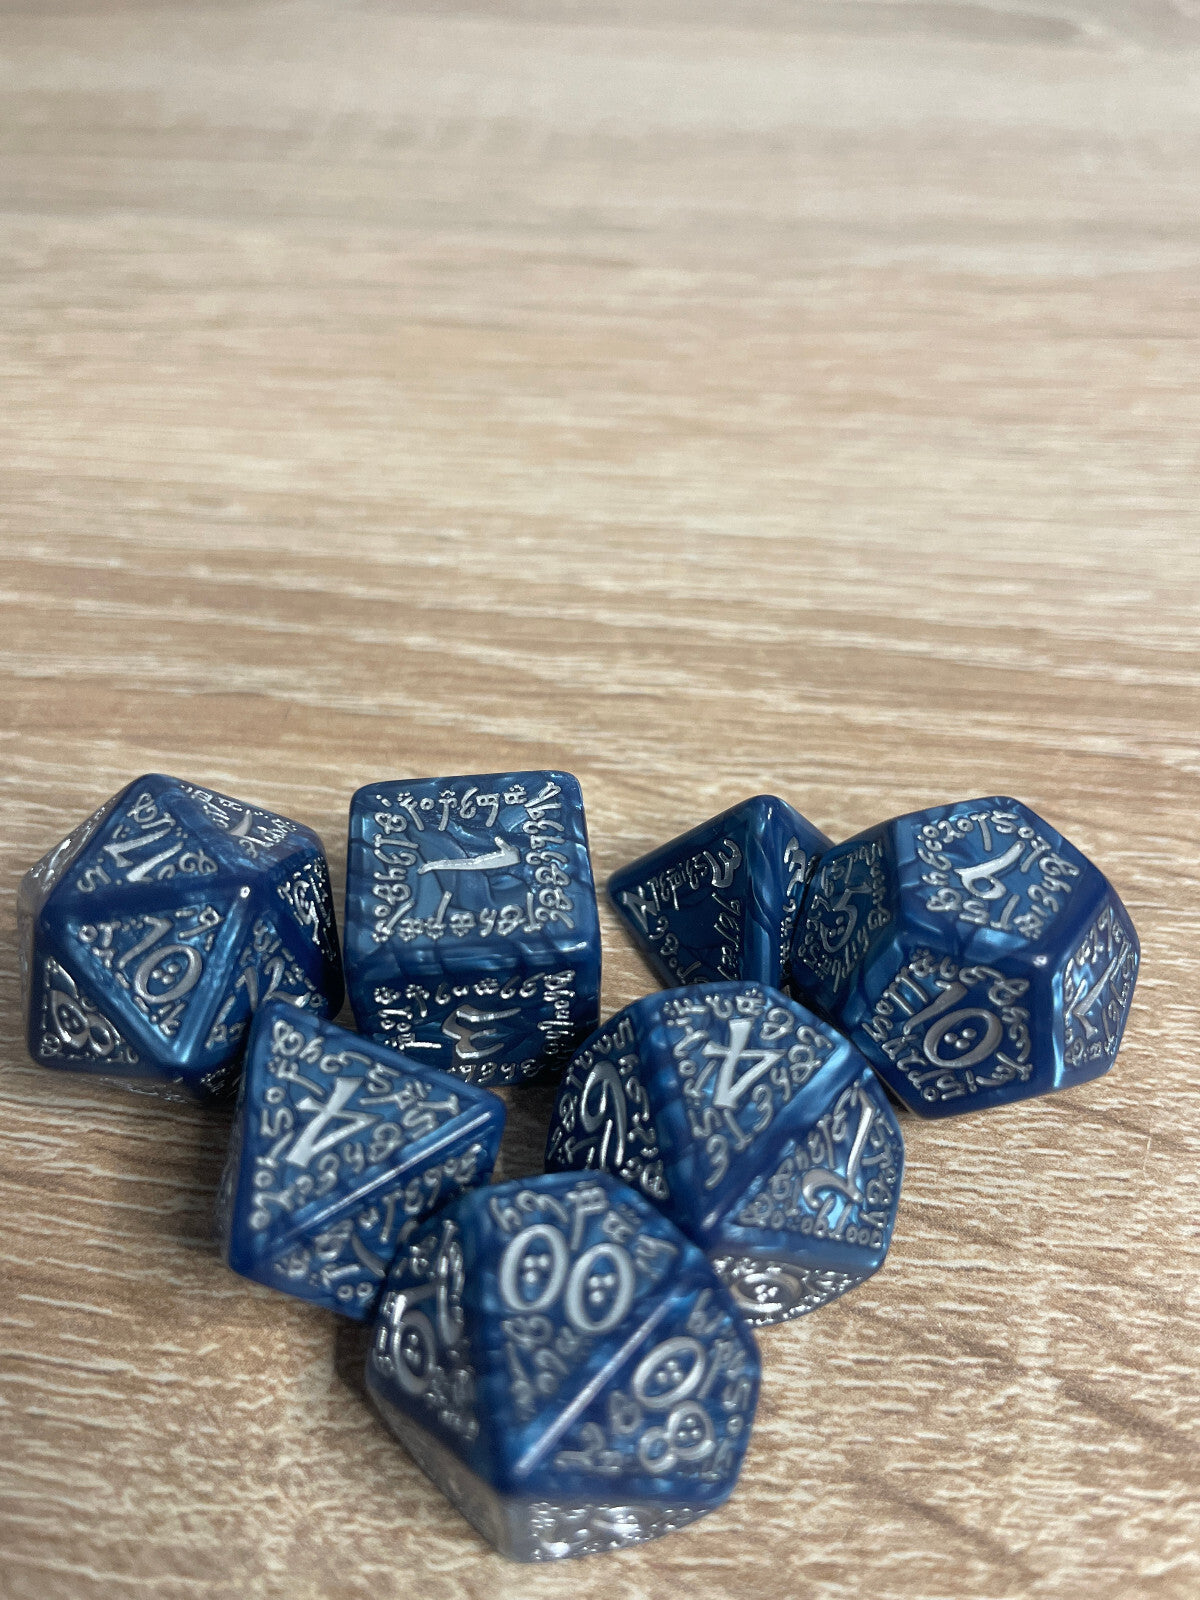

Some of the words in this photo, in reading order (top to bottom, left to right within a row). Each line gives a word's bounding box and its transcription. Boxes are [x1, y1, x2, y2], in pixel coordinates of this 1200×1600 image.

[103, 824, 184, 882] 17
[417, 836, 521, 875] 1
[704, 839, 742, 888] 3
[820, 882, 873, 953] 5
[117, 915, 202, 1003] 10
[51, 989, 114, 1054] 8
[442, 1004, 521, 1059] 3
[903, 980, 1004, 1069] 10
[701, 1018, 789, 1109] 4
[286, 1077, 384, 1167] 4
[501, 1224, 636, 1333] 00
